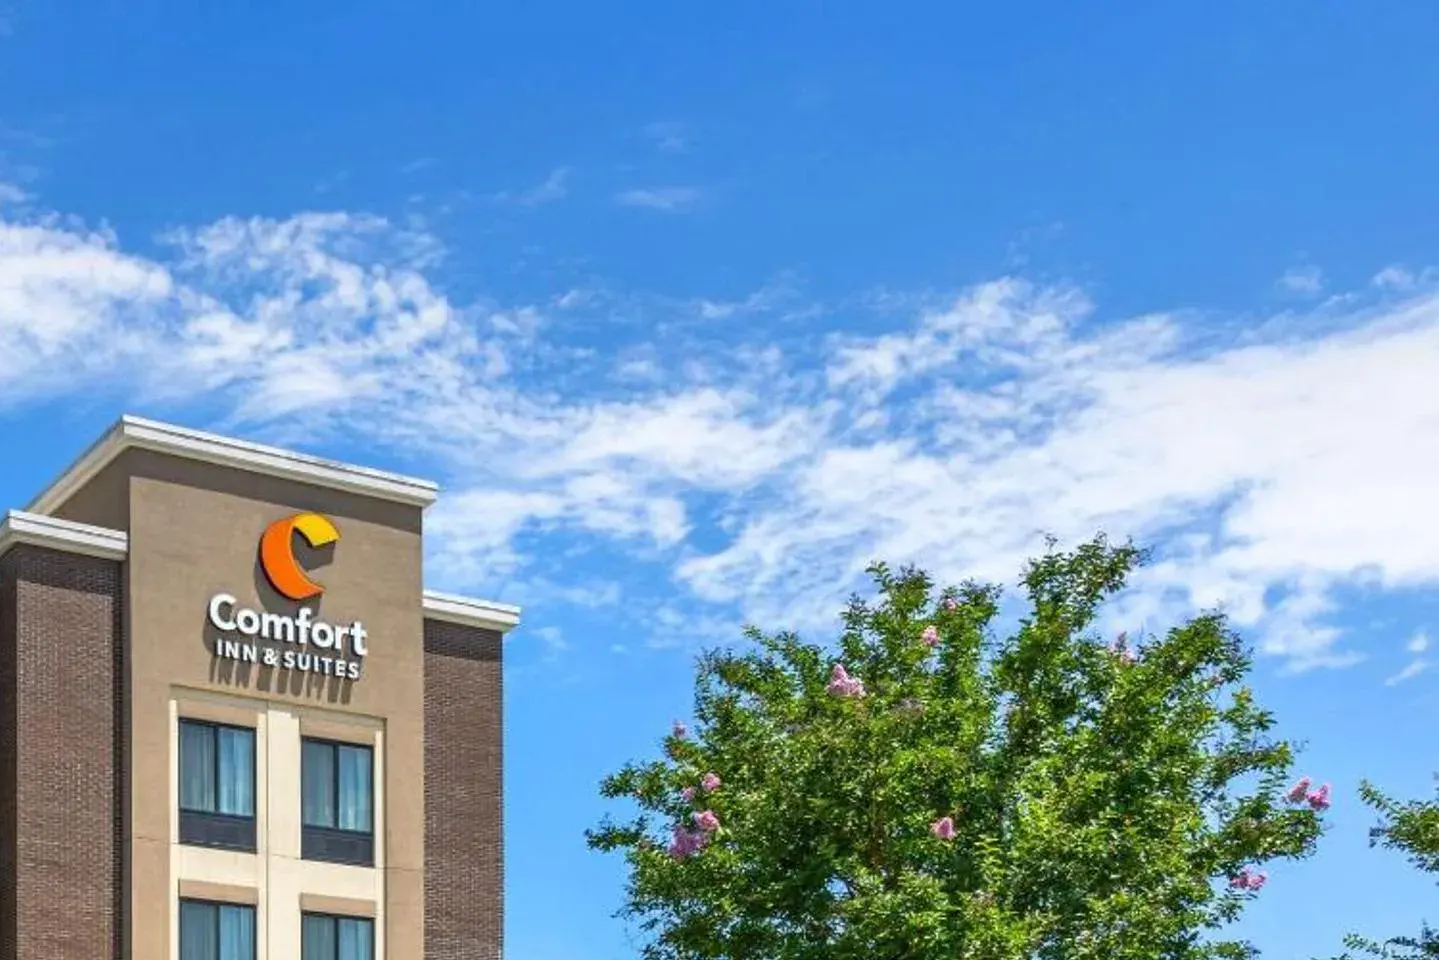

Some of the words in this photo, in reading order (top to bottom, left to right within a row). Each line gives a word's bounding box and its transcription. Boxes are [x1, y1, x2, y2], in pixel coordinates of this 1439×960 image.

[210, 594, 368, 656] Comfort
[216, 639, 257, 663] INN
[264, 648, 278, 666] &
[284, 651, 360, 679] SUITES
